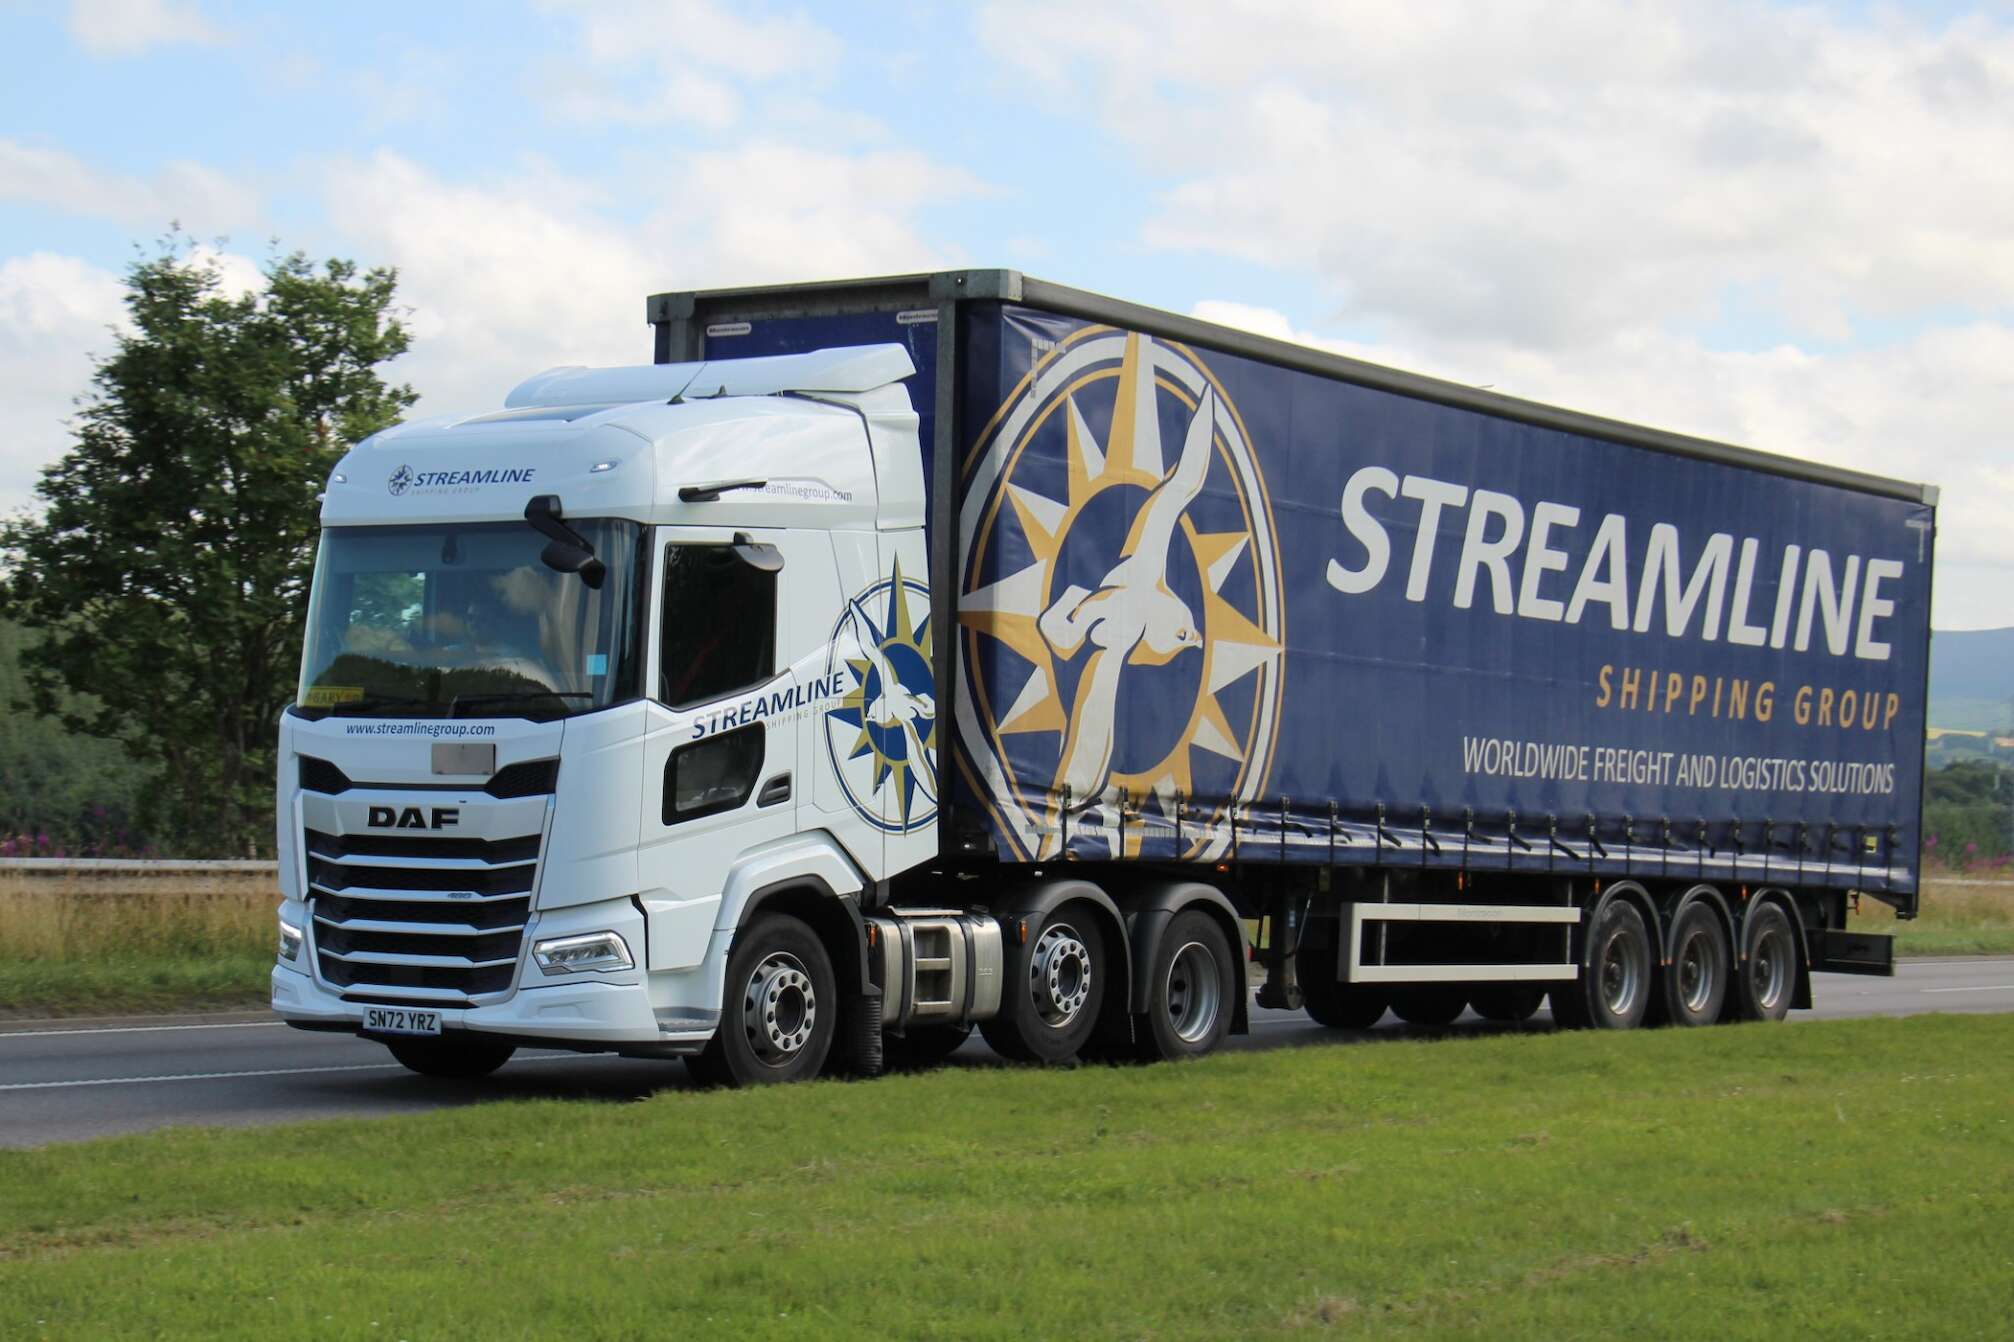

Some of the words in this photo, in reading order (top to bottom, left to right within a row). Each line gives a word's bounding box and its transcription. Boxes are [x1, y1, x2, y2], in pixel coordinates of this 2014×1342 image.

[414, 469, 536, 487] STREAMLINE
[1326, 466, 1904, 661] STREAMLINE
[692, 671, 844, 739] STREAMLINE
[1597, 664, 1775, 722] SHIPPING
[1794, 685, 1900, 730] GROUP
[346, 721, 496, 738] www.streamlinegroup.com
[766, 707, 809, 730] SHIPPING
[1463, 736, 1590, 782] WORLDWIDE
[1593, 747, 1675, 786] FREIGHT
[1676, 754, 1716, 788] AND
[1720, 756, 1807, 792] LOGISTICS
[1808, 760, 1896, 795] SOLUTIONS
[368, 806, 460, 829] DAF
[368, 1009, 404, 1029] SN72
[407, 1012, 436, 1031] YRZ
